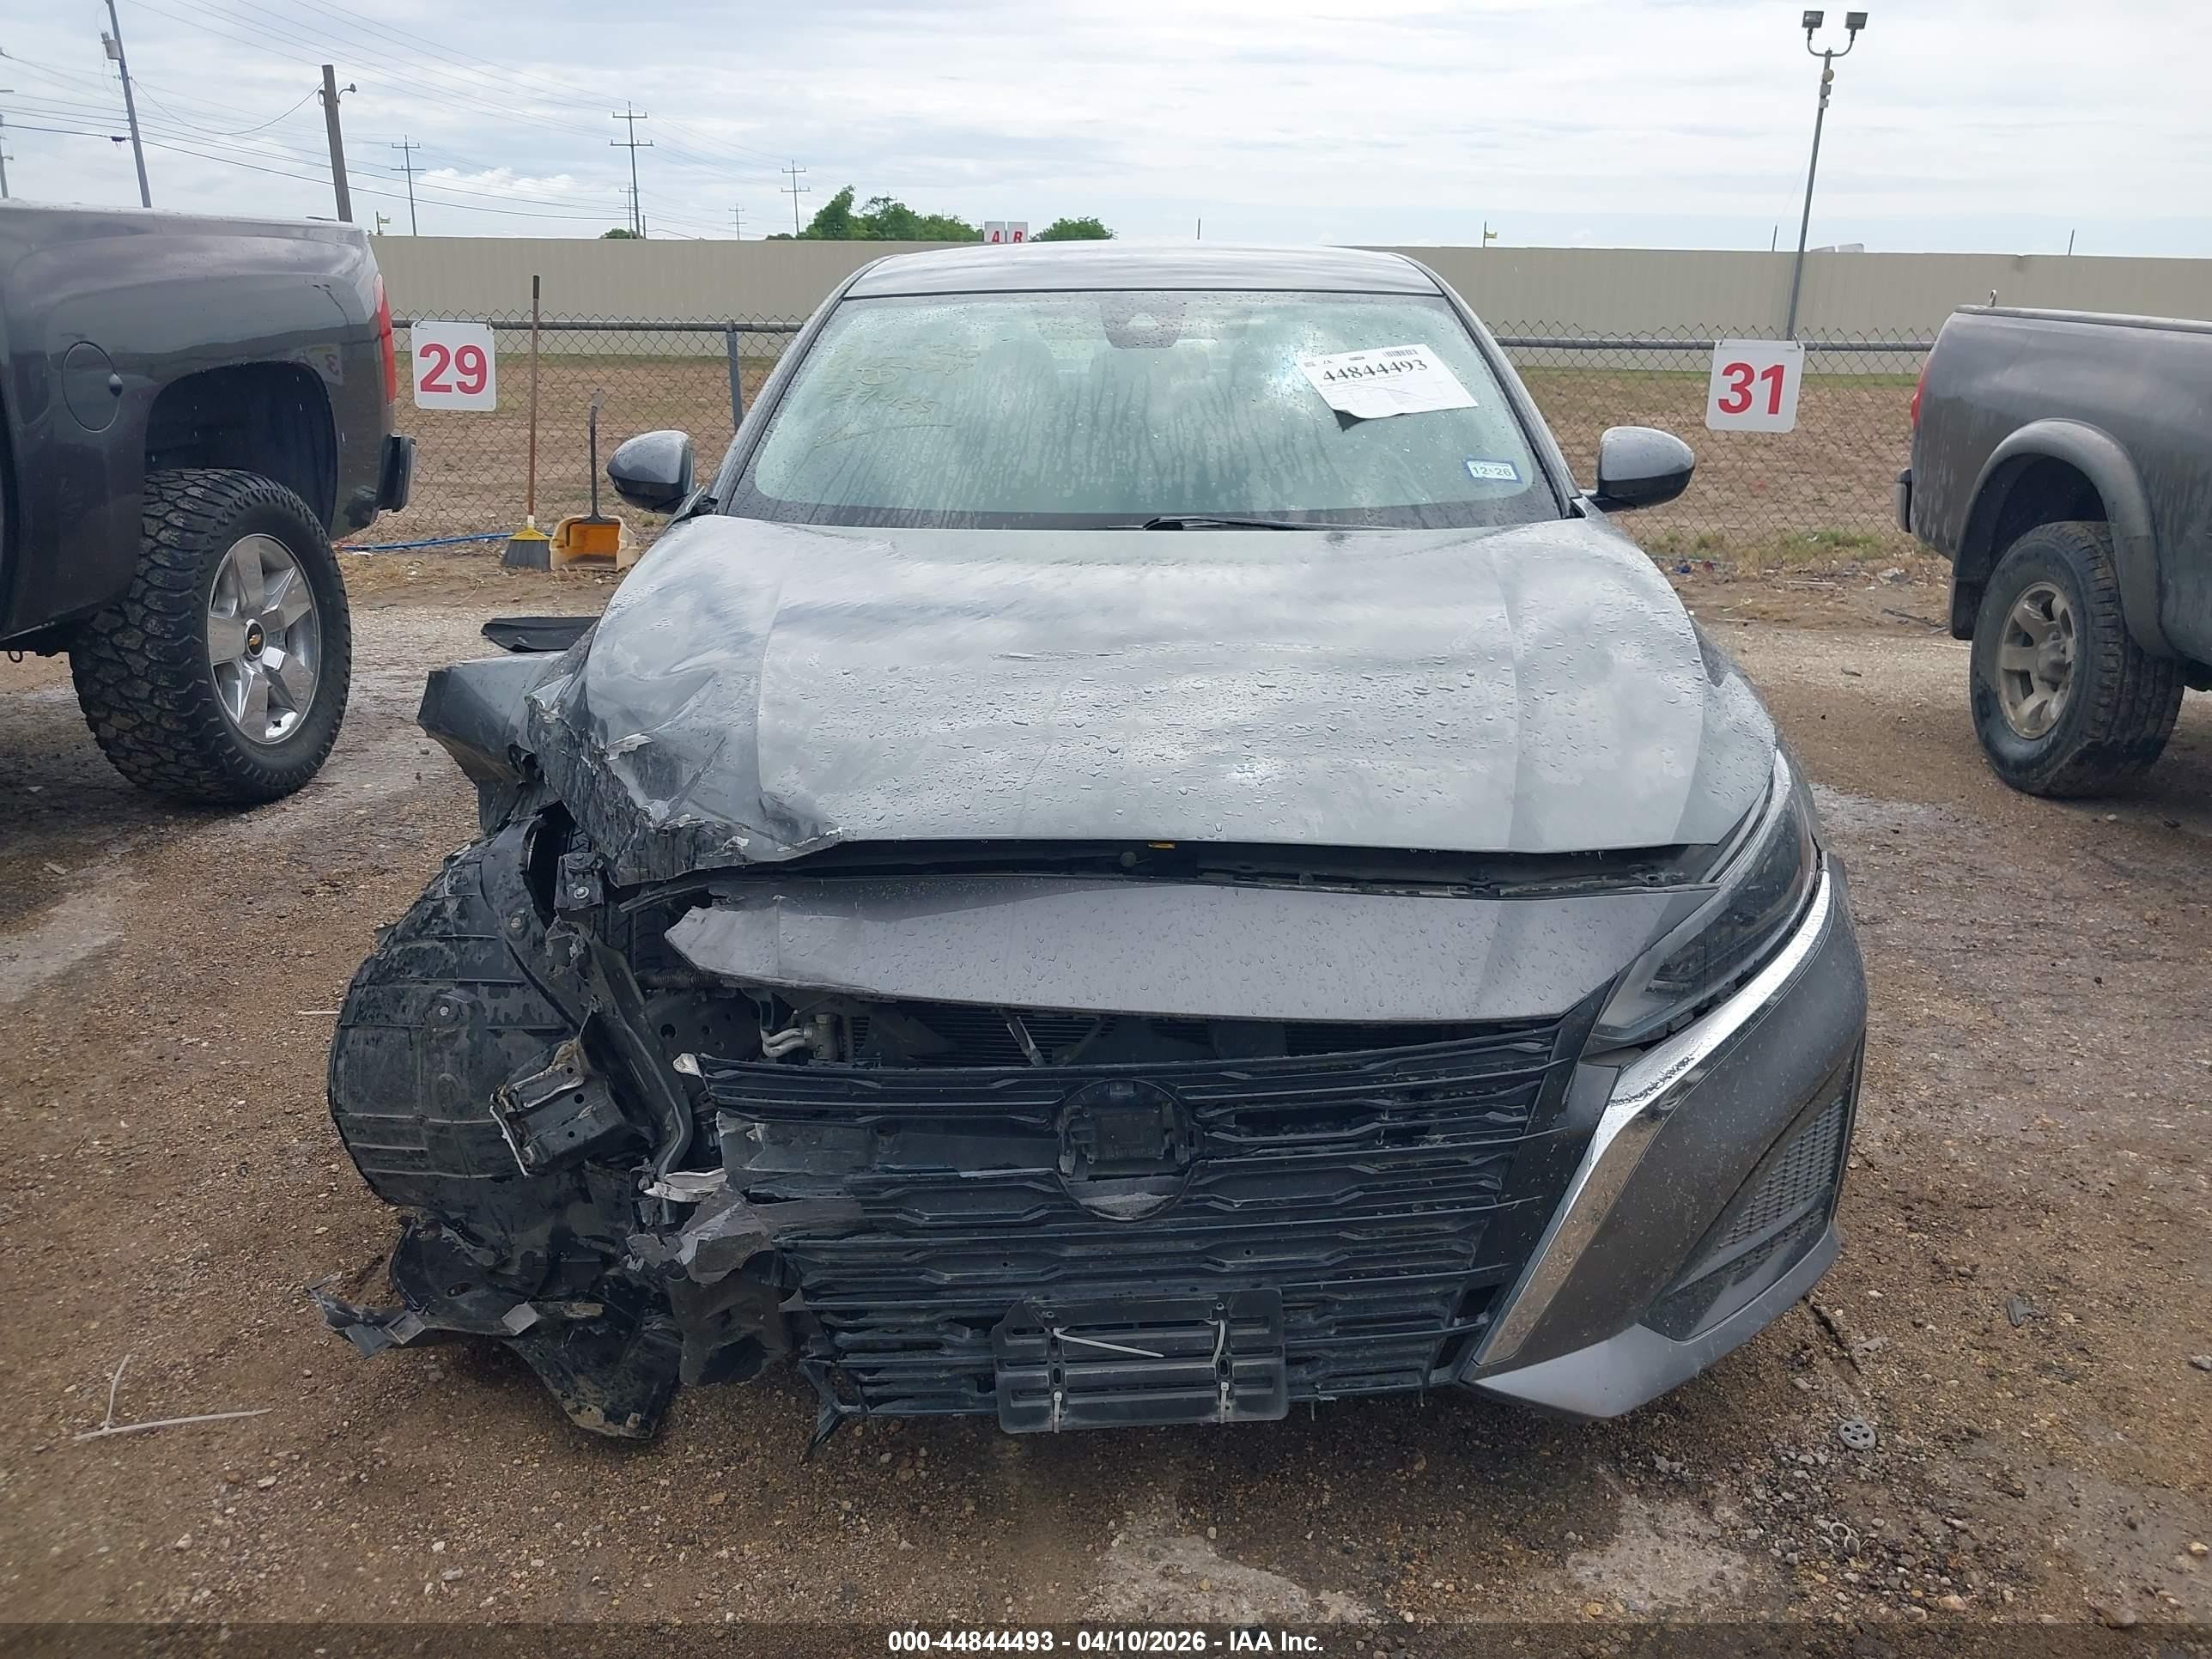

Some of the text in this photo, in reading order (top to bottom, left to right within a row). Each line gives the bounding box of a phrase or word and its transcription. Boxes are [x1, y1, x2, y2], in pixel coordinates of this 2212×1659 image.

[419, 343, 487, 395] 29
[1323, 359, 1428, 381] 44844493
[1717, 362, 1784, 415] 31
